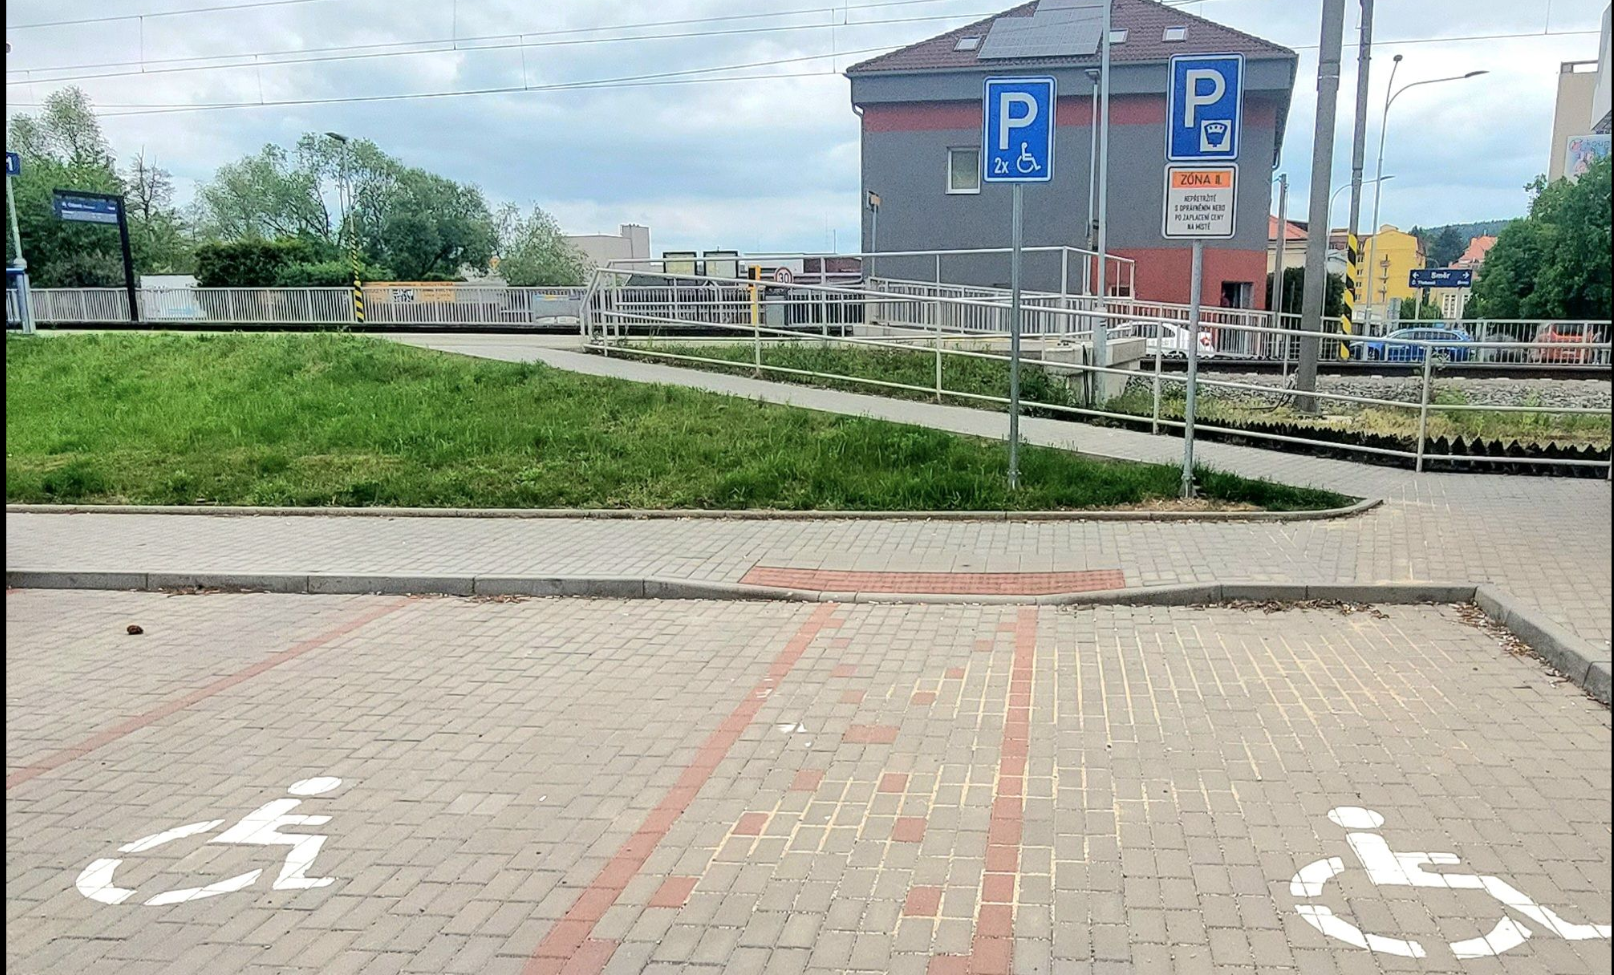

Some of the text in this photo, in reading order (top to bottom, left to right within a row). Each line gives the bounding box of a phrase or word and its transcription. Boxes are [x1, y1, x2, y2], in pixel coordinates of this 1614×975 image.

[1184, 68, 1226, 128] P
[999, 92, 1038, 150] P
[994, 157, 1009, 174] 2x
[1180, 172, 1211, 185] ZÓNA
[778, 273, 789, 284] 30
